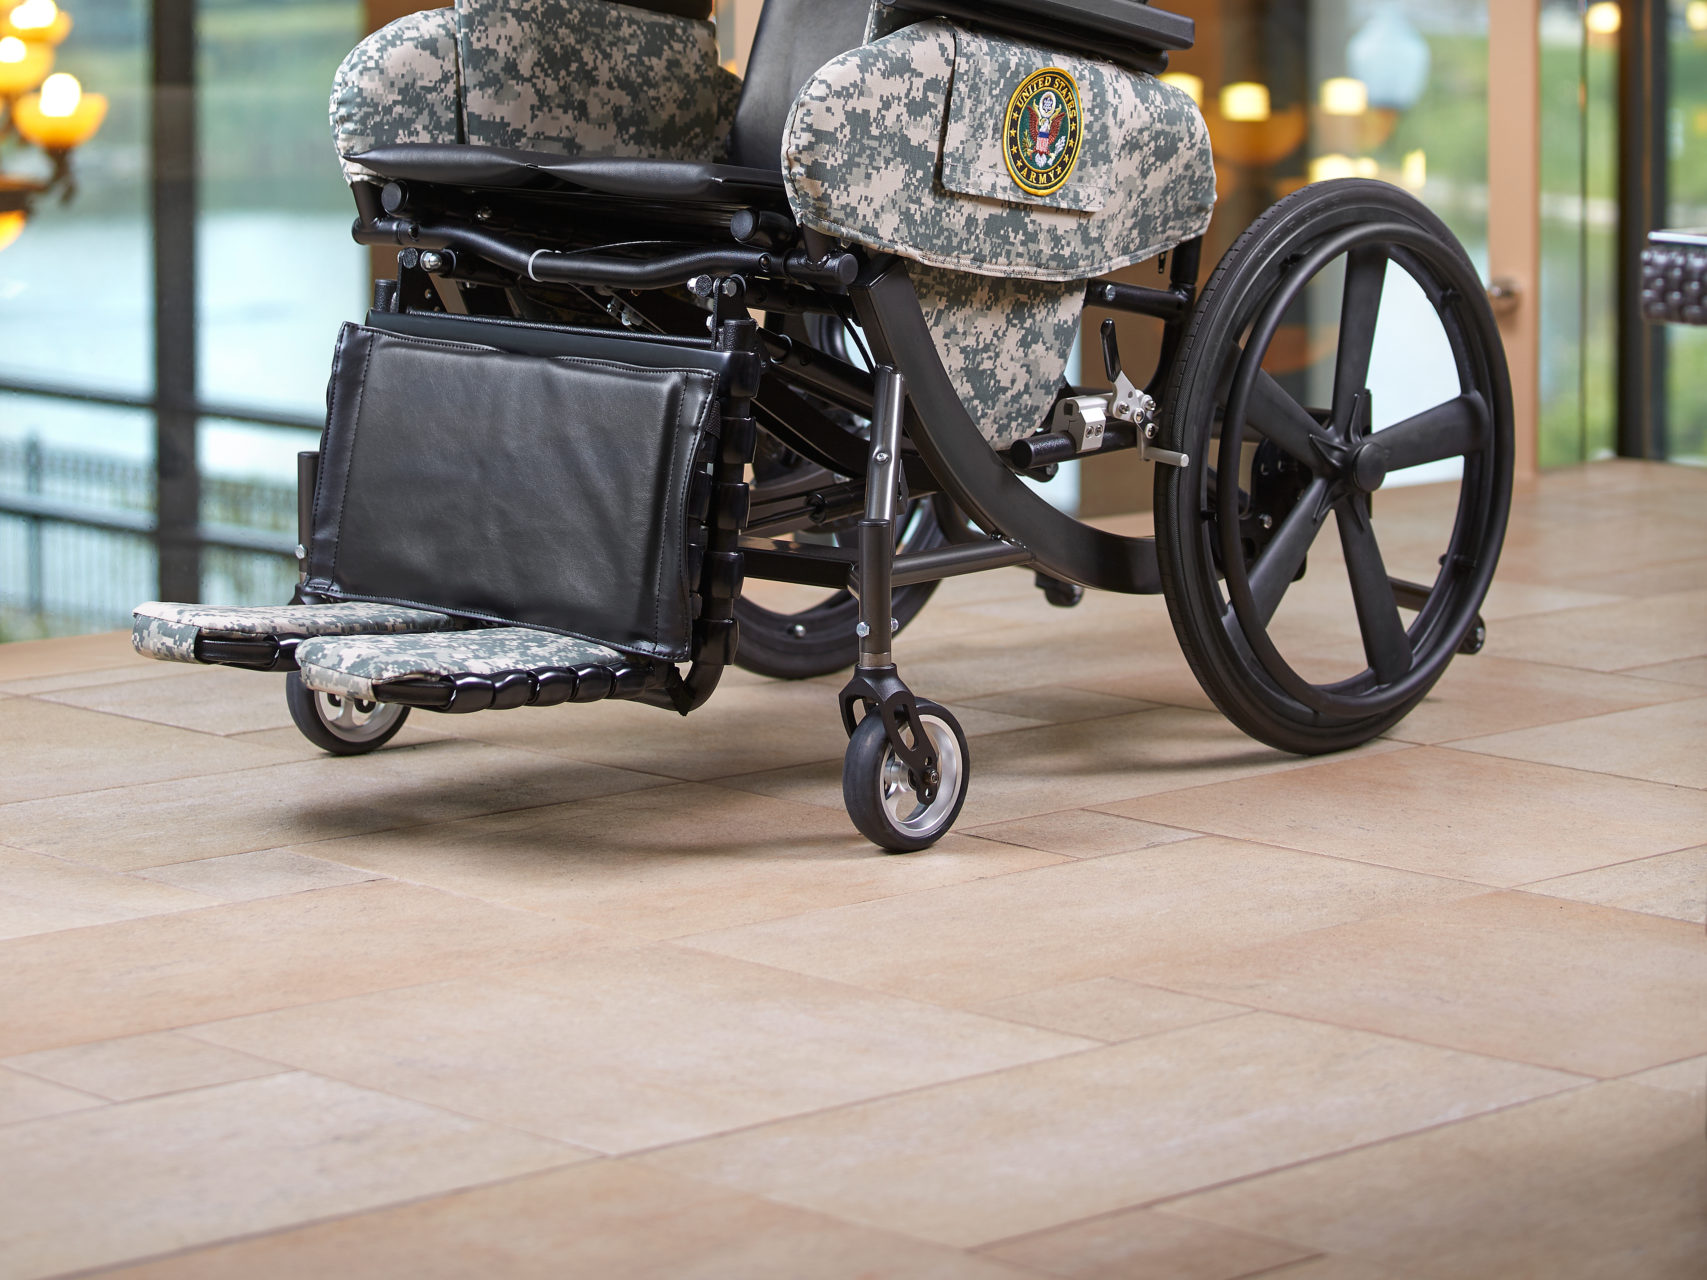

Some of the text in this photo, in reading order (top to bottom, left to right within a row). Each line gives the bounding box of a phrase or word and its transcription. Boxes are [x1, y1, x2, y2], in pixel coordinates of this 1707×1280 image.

[1016, 77, 1076, 118] UNITED STATES
[1021, 168, 1055, 184] ARMY
